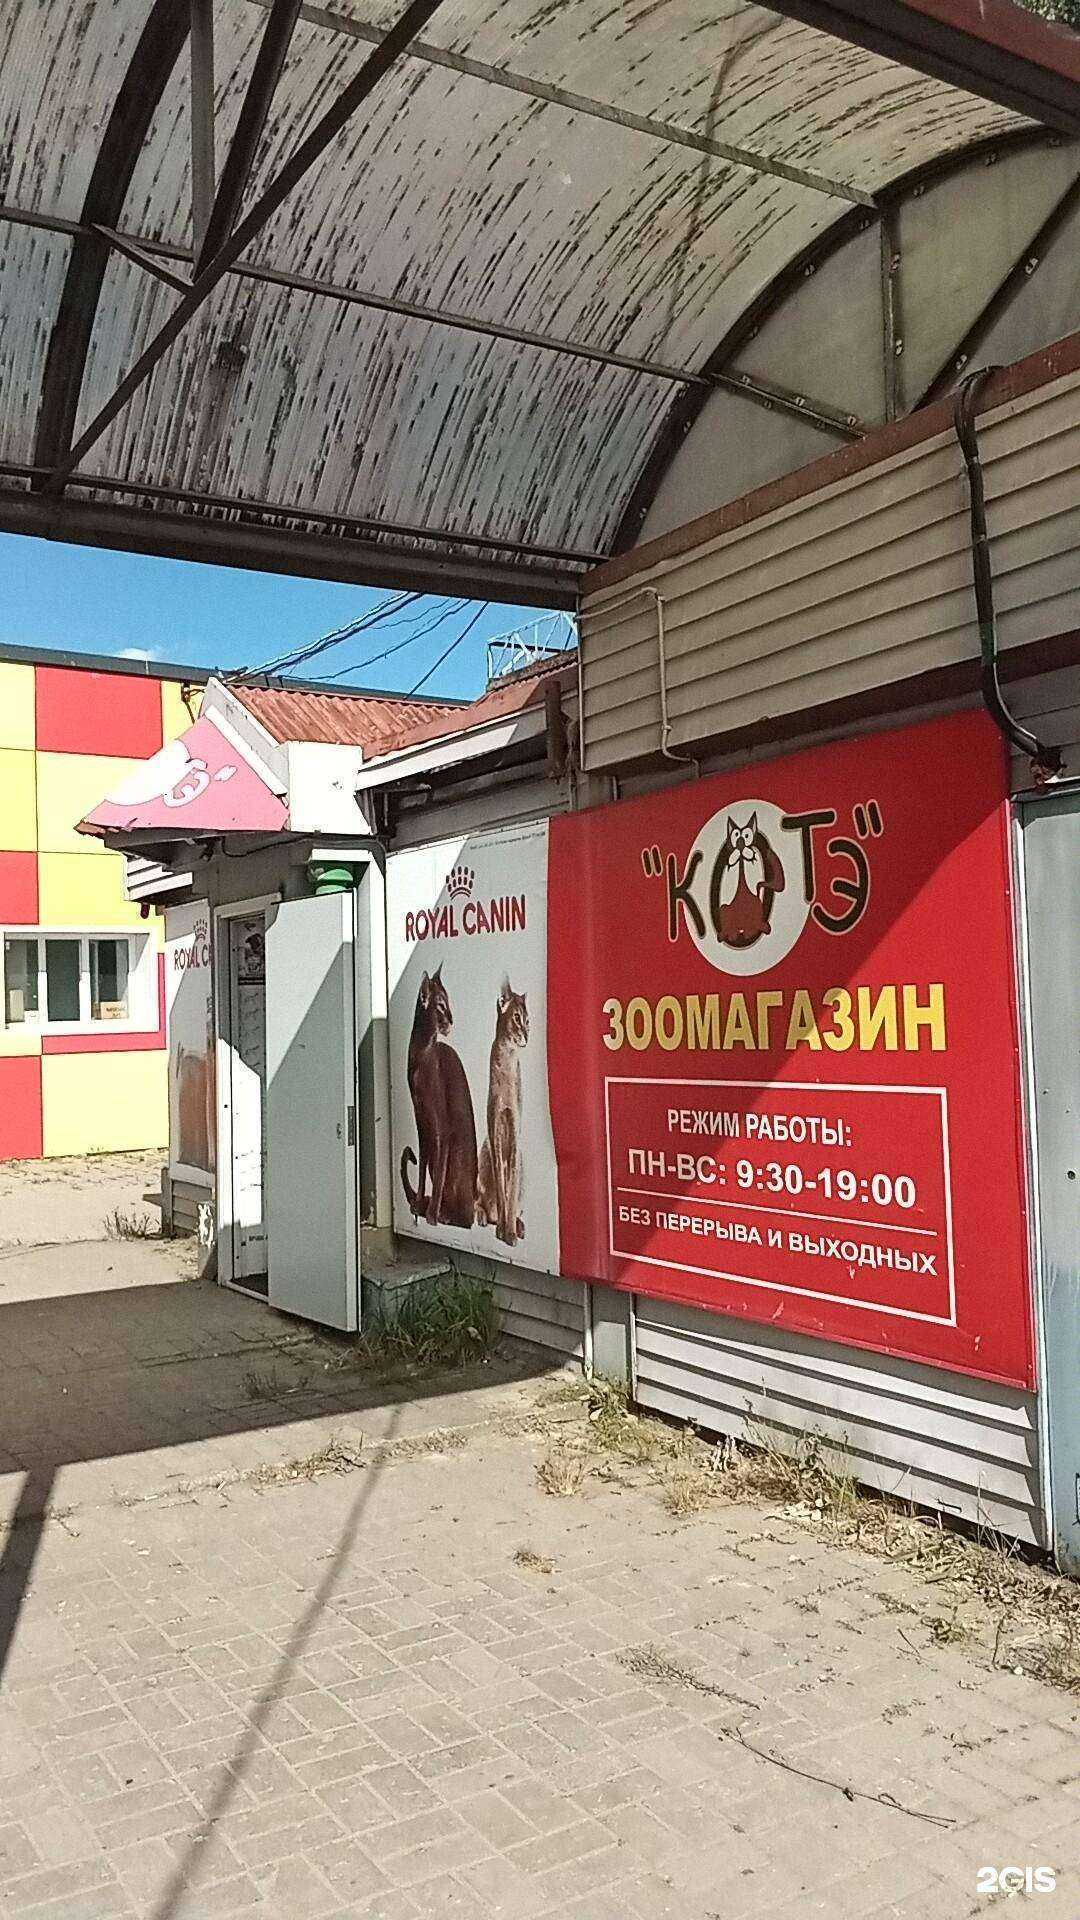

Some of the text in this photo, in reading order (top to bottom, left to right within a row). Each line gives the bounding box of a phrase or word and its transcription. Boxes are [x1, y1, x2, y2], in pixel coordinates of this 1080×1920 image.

[405, 894, 526, 942] ROYAL CANIN
[174, 947, 200, 970] ROYAL
[602, 983, 947, 1051] ЗООМАГАЗИН
[667, 1108, 852, 1147] РЕЖИМ РАБОТЫ:
[628, 1148, 917, 1209] ПН-ВС: 9:30-19:00
[619, 1205, 938, 1276] БЕЗ ПЕРЕРЫВА И ВЫХОДНЫХ
